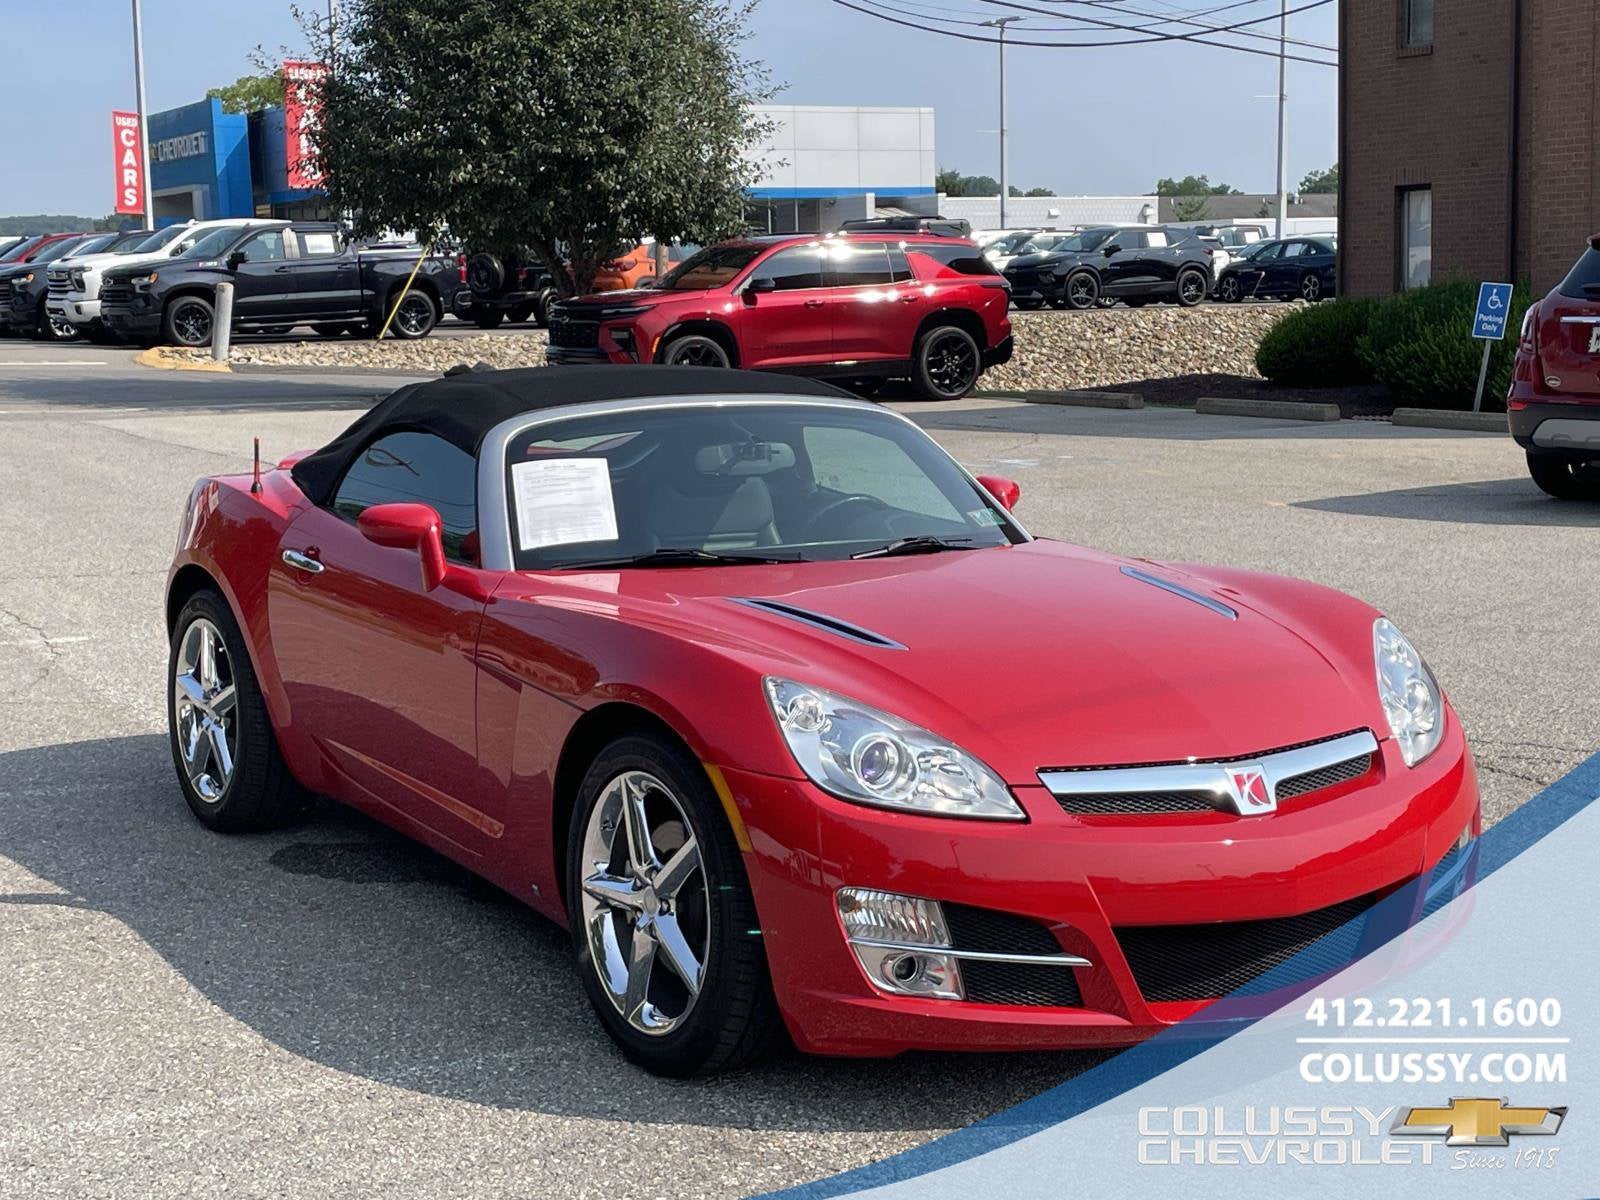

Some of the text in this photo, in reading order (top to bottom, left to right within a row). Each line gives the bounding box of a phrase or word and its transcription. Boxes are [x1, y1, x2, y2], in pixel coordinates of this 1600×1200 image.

[115, 116, 138, 126] USED
[158, 131, 208, 162] CHEVROLET
[120, 128, 138, 206] CARS
[1479, 313, 1504, 324] Parking
[1481, 323, 1498, 333] Only
